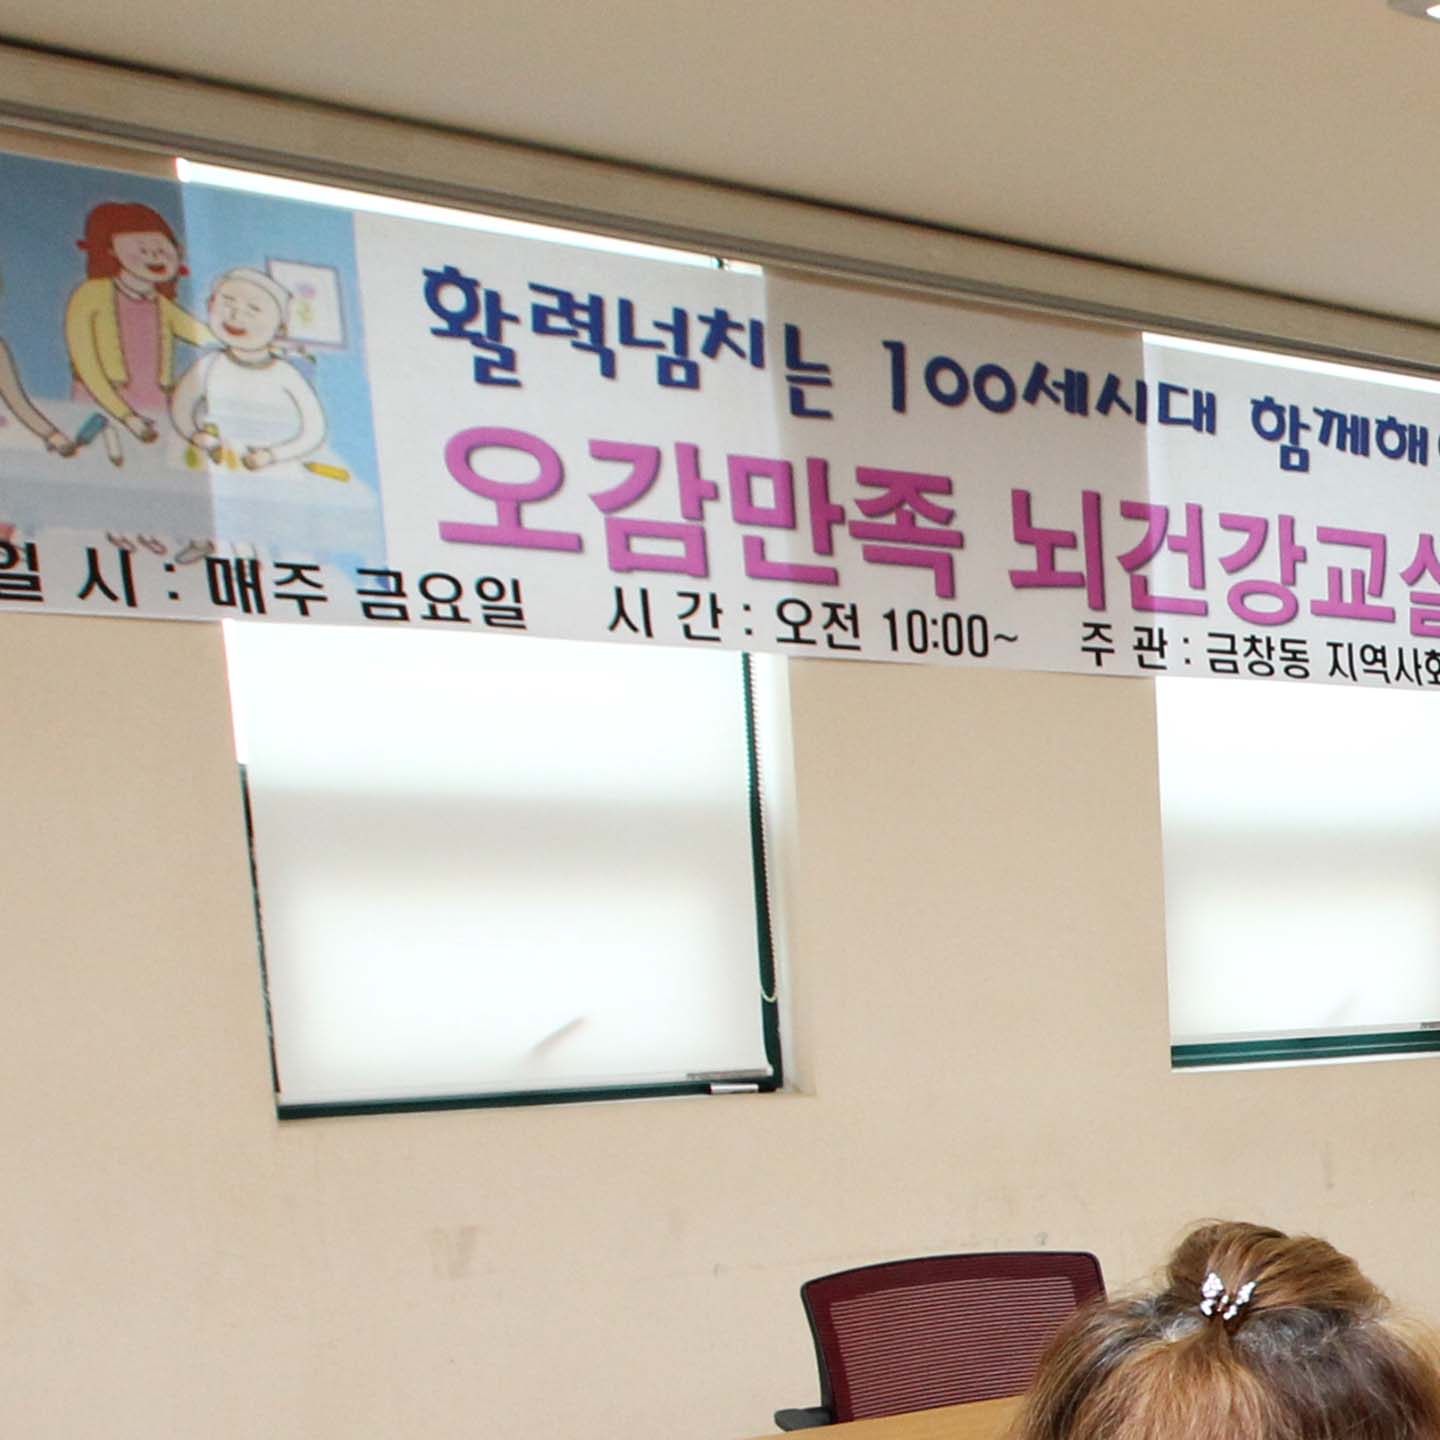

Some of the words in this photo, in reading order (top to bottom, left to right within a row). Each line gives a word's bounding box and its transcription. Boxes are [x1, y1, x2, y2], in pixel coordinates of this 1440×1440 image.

[422, 265, 834, 420] 활력넘치는
[882, 341, 1217, 436] 100세시대
[438, 426, 965, 600] 오감만족
[205, 555, 328, 617] 매주
[356, 566, 528, 631] 금요일
[776, 597, 862, 652] 오전
[1206, 632, 1311, 680] 금창동
